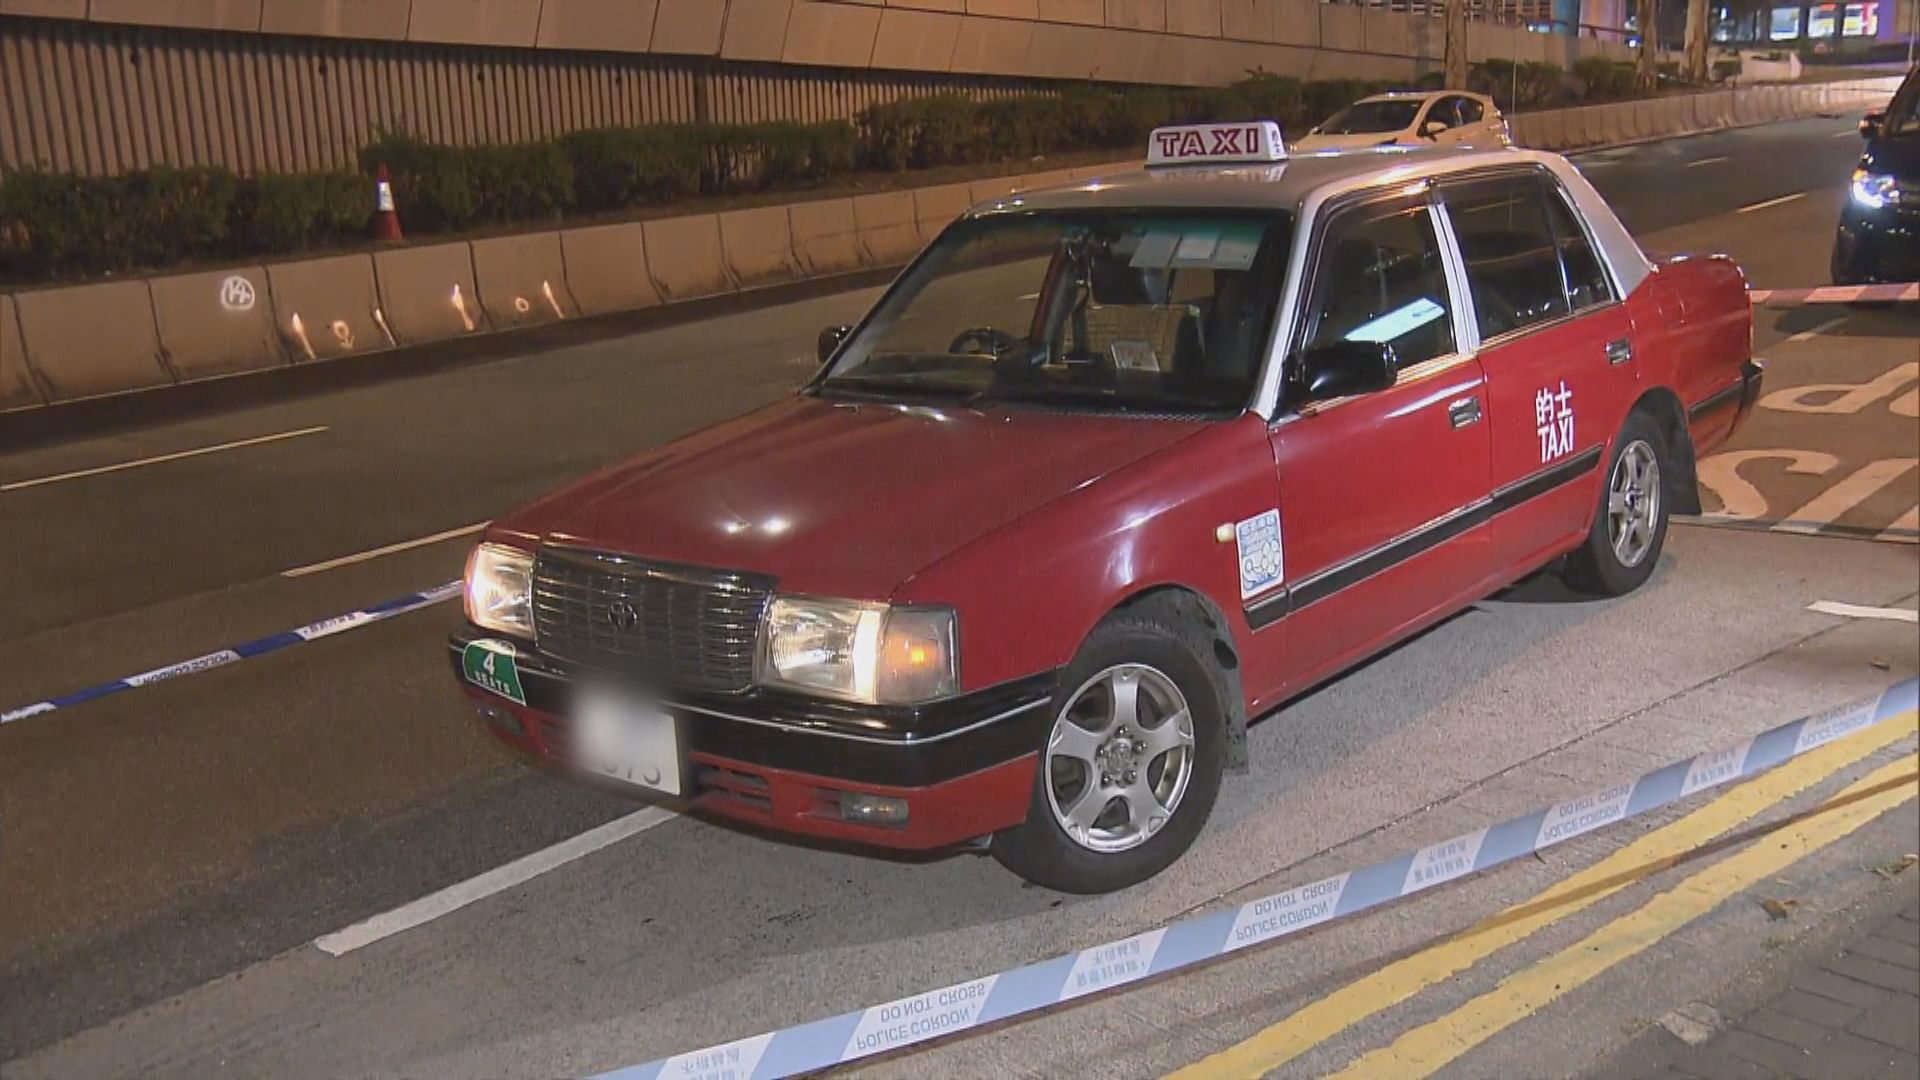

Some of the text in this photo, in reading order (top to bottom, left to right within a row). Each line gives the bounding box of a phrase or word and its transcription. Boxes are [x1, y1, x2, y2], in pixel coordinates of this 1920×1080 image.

[1157, 128, 1259, 157] TAXI
[1536, 380, 1572, 427] 的士
[1537, 415, 1574, 463] TAXI
[483, 652, 495, 675] 4
